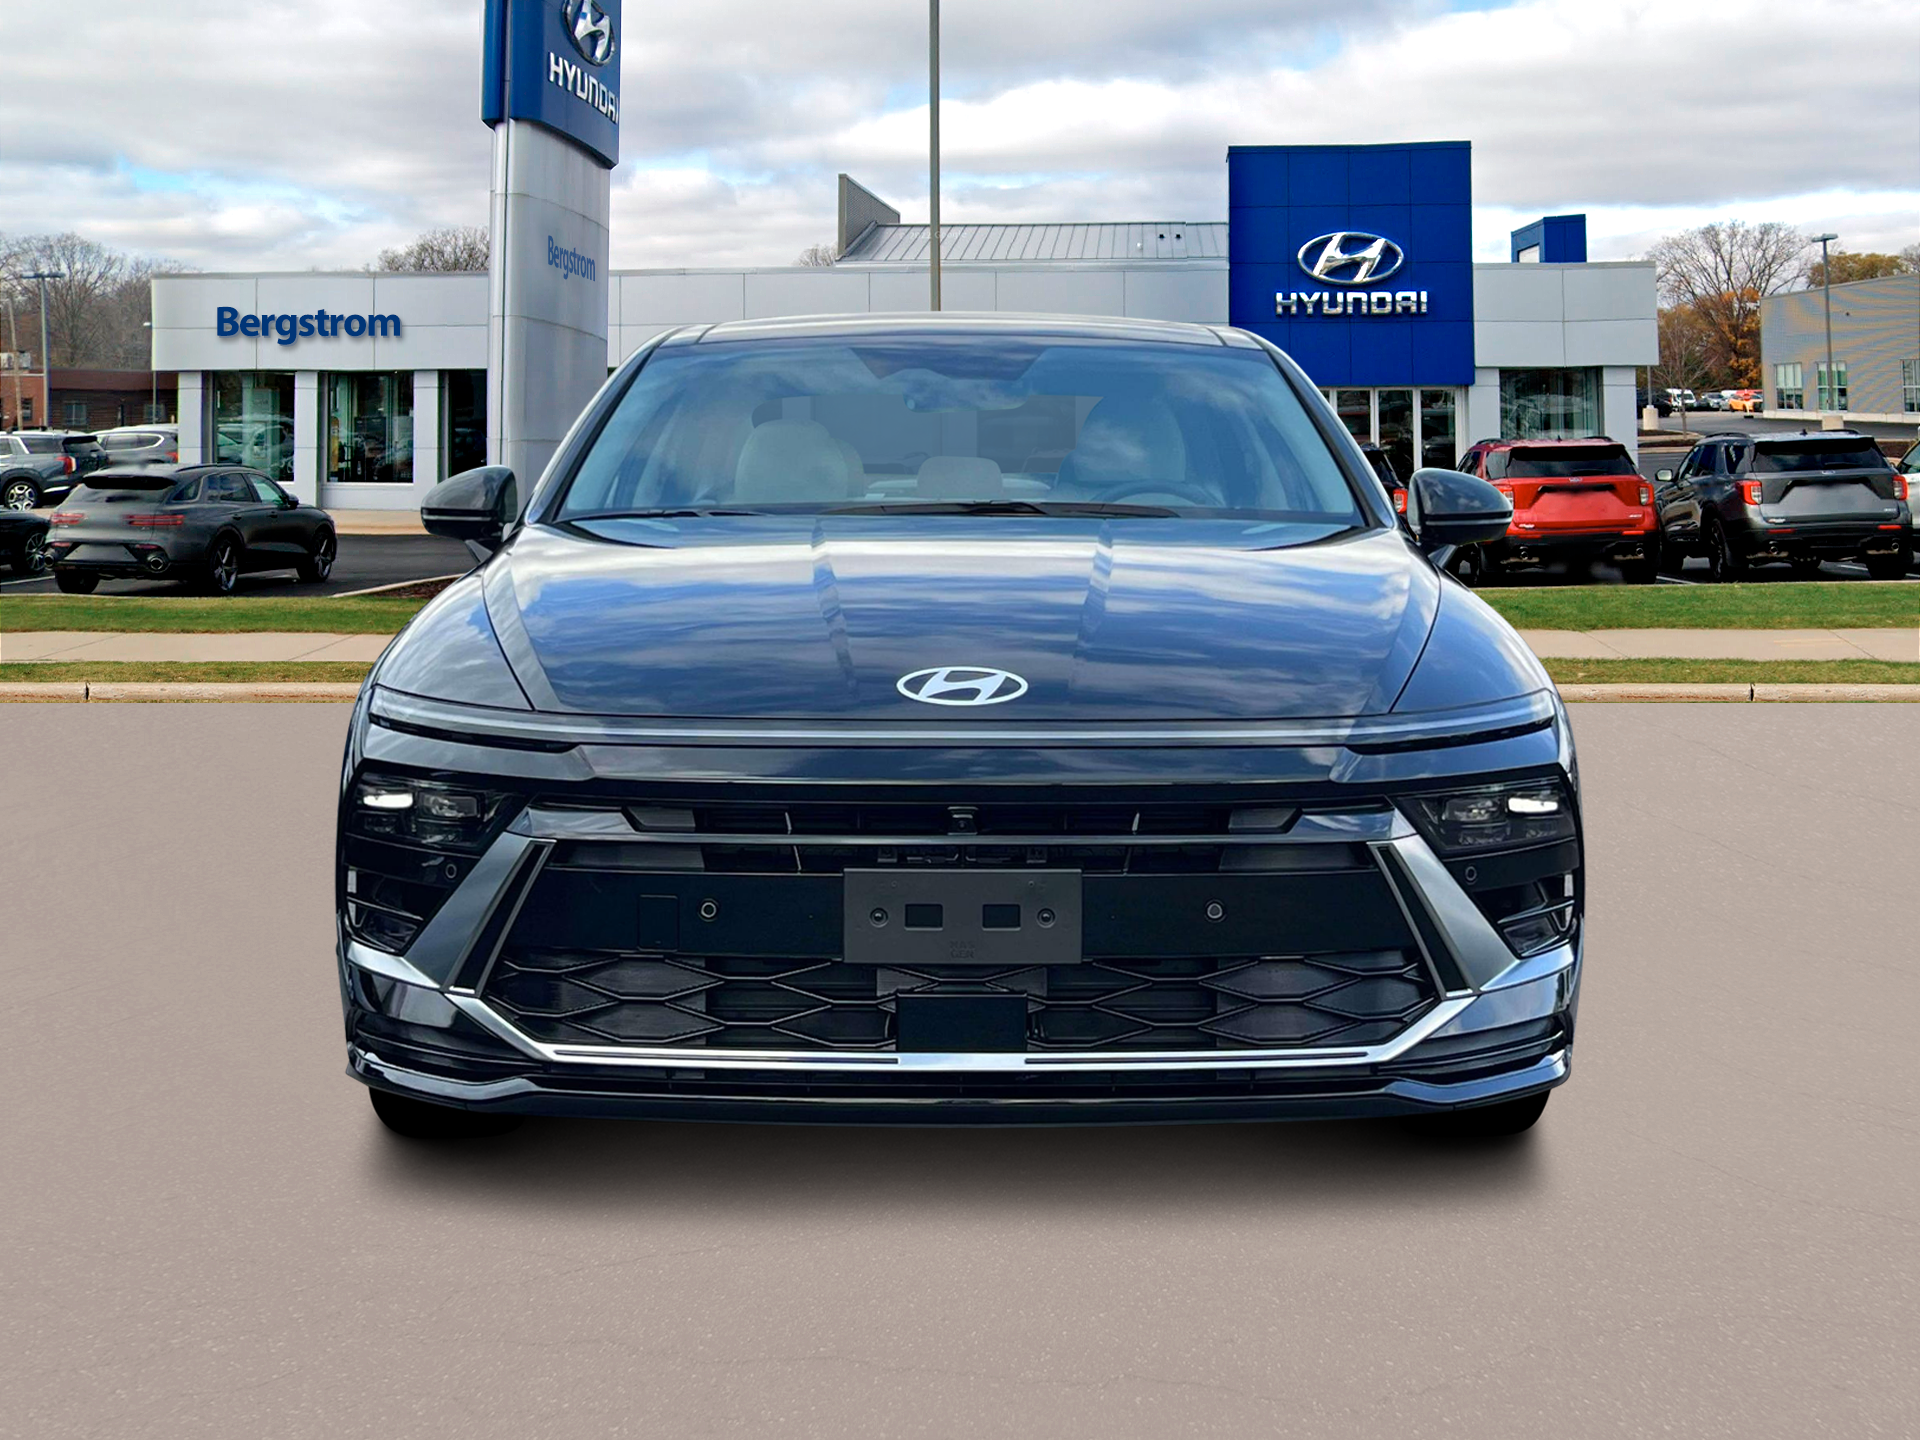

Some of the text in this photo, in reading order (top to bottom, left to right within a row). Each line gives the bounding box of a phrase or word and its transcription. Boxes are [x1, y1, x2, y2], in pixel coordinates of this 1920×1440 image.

[549, 51, 619, 124] HYUNDAI
[548, 235, 596, 282] Bergstrom
[1276, 291, 1428, 315] HYUNDAI
[217, 306, 402, 346] Bergstrom
